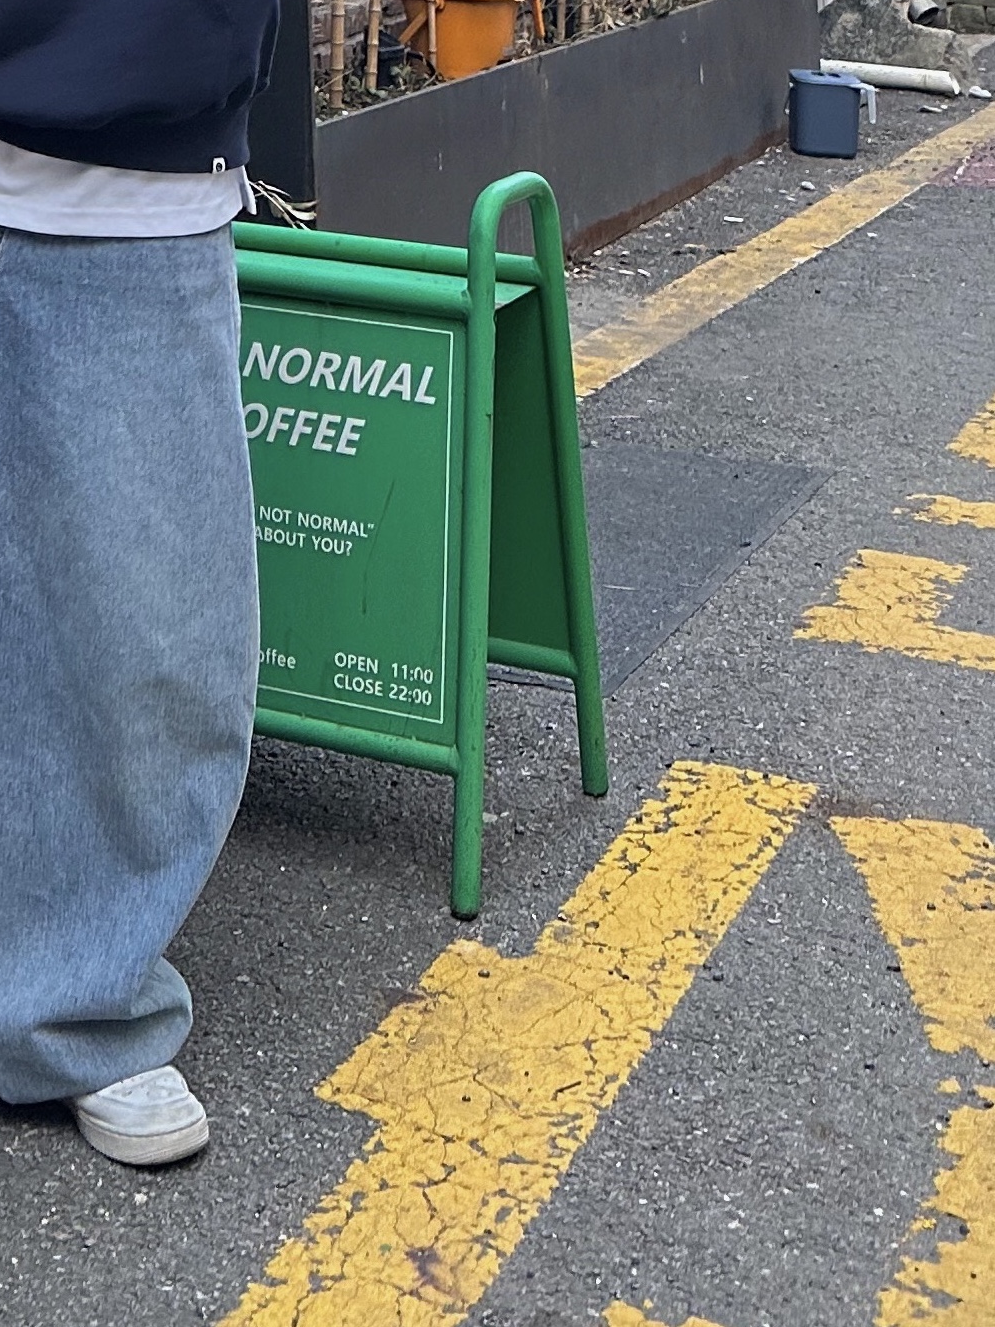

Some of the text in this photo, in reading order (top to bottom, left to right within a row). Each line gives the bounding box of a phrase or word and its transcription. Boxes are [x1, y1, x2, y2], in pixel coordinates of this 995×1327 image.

[242, 341, 436, 405] NORMAL
[243, 402, 366, 456] OFFEE
[259, 505, 293, 525] NOT
[311, 535, 353, 557] YOU?
[259, 647, 297, 670] offee
[333, 651, 434, 685] OPEN 11:00
[333, 673, 432, 706] CLOSE 22:00
